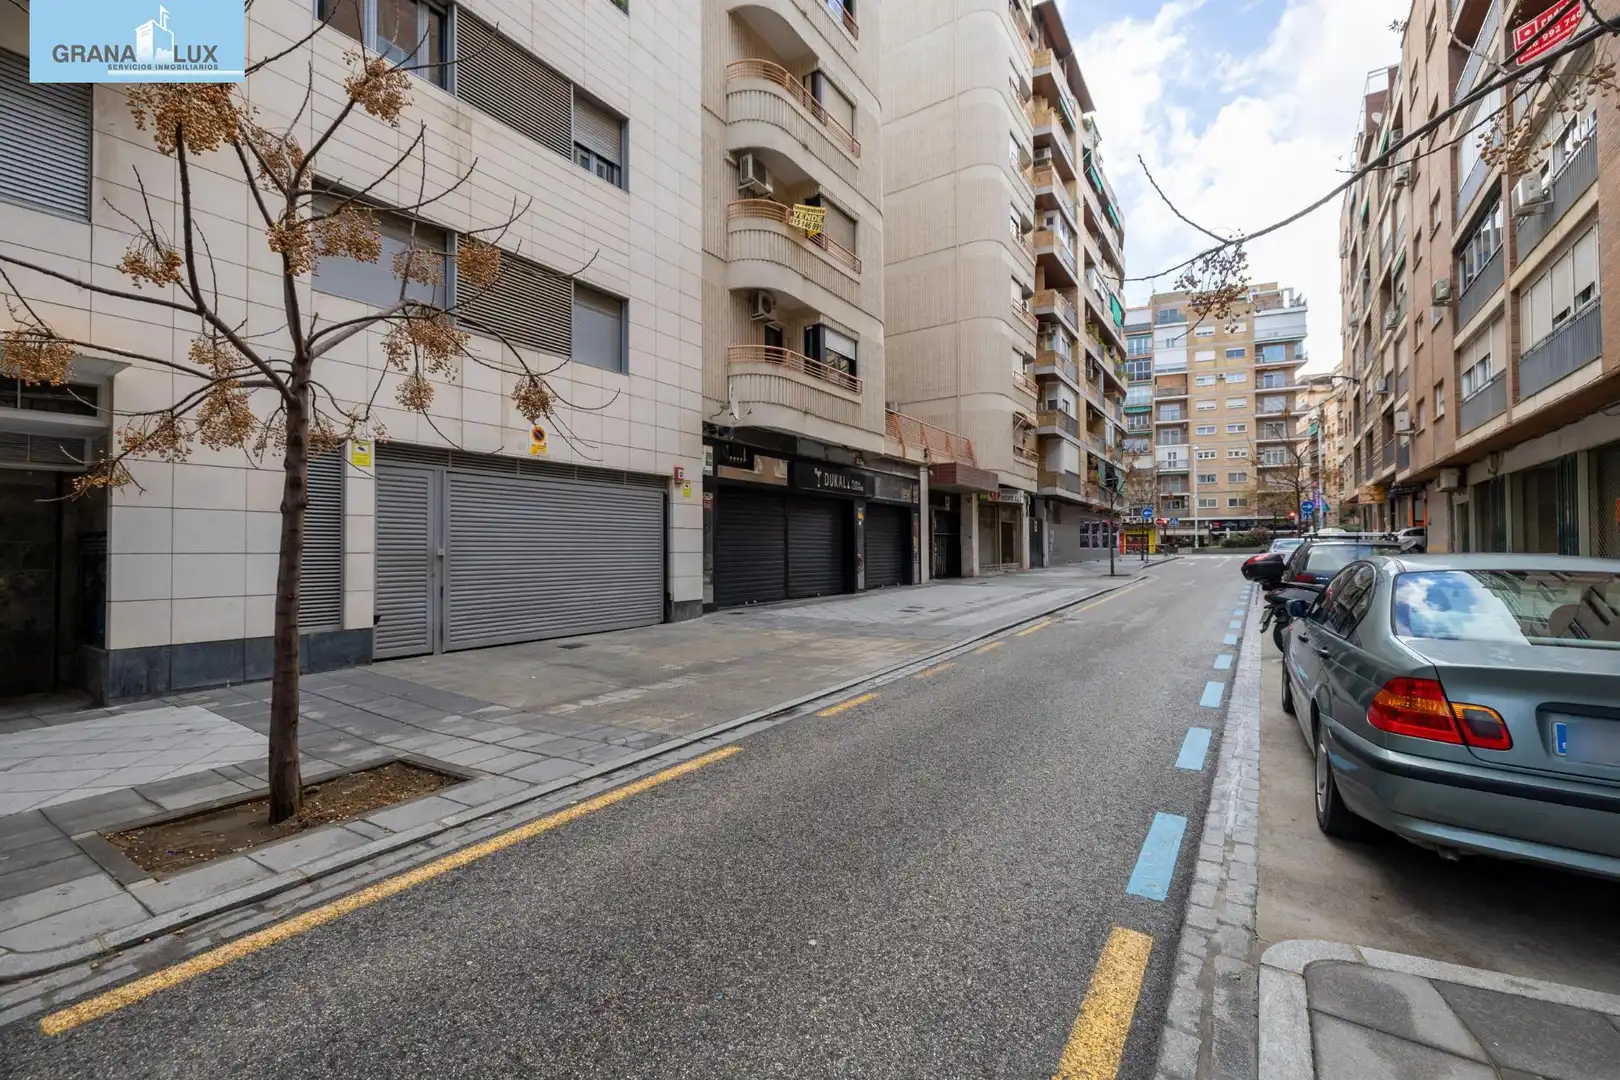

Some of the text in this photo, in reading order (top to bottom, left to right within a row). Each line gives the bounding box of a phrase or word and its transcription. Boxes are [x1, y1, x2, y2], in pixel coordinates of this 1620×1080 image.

[1542, 11, 1581, 42] 992 740
[794, 211, 823, 223] VENDE
